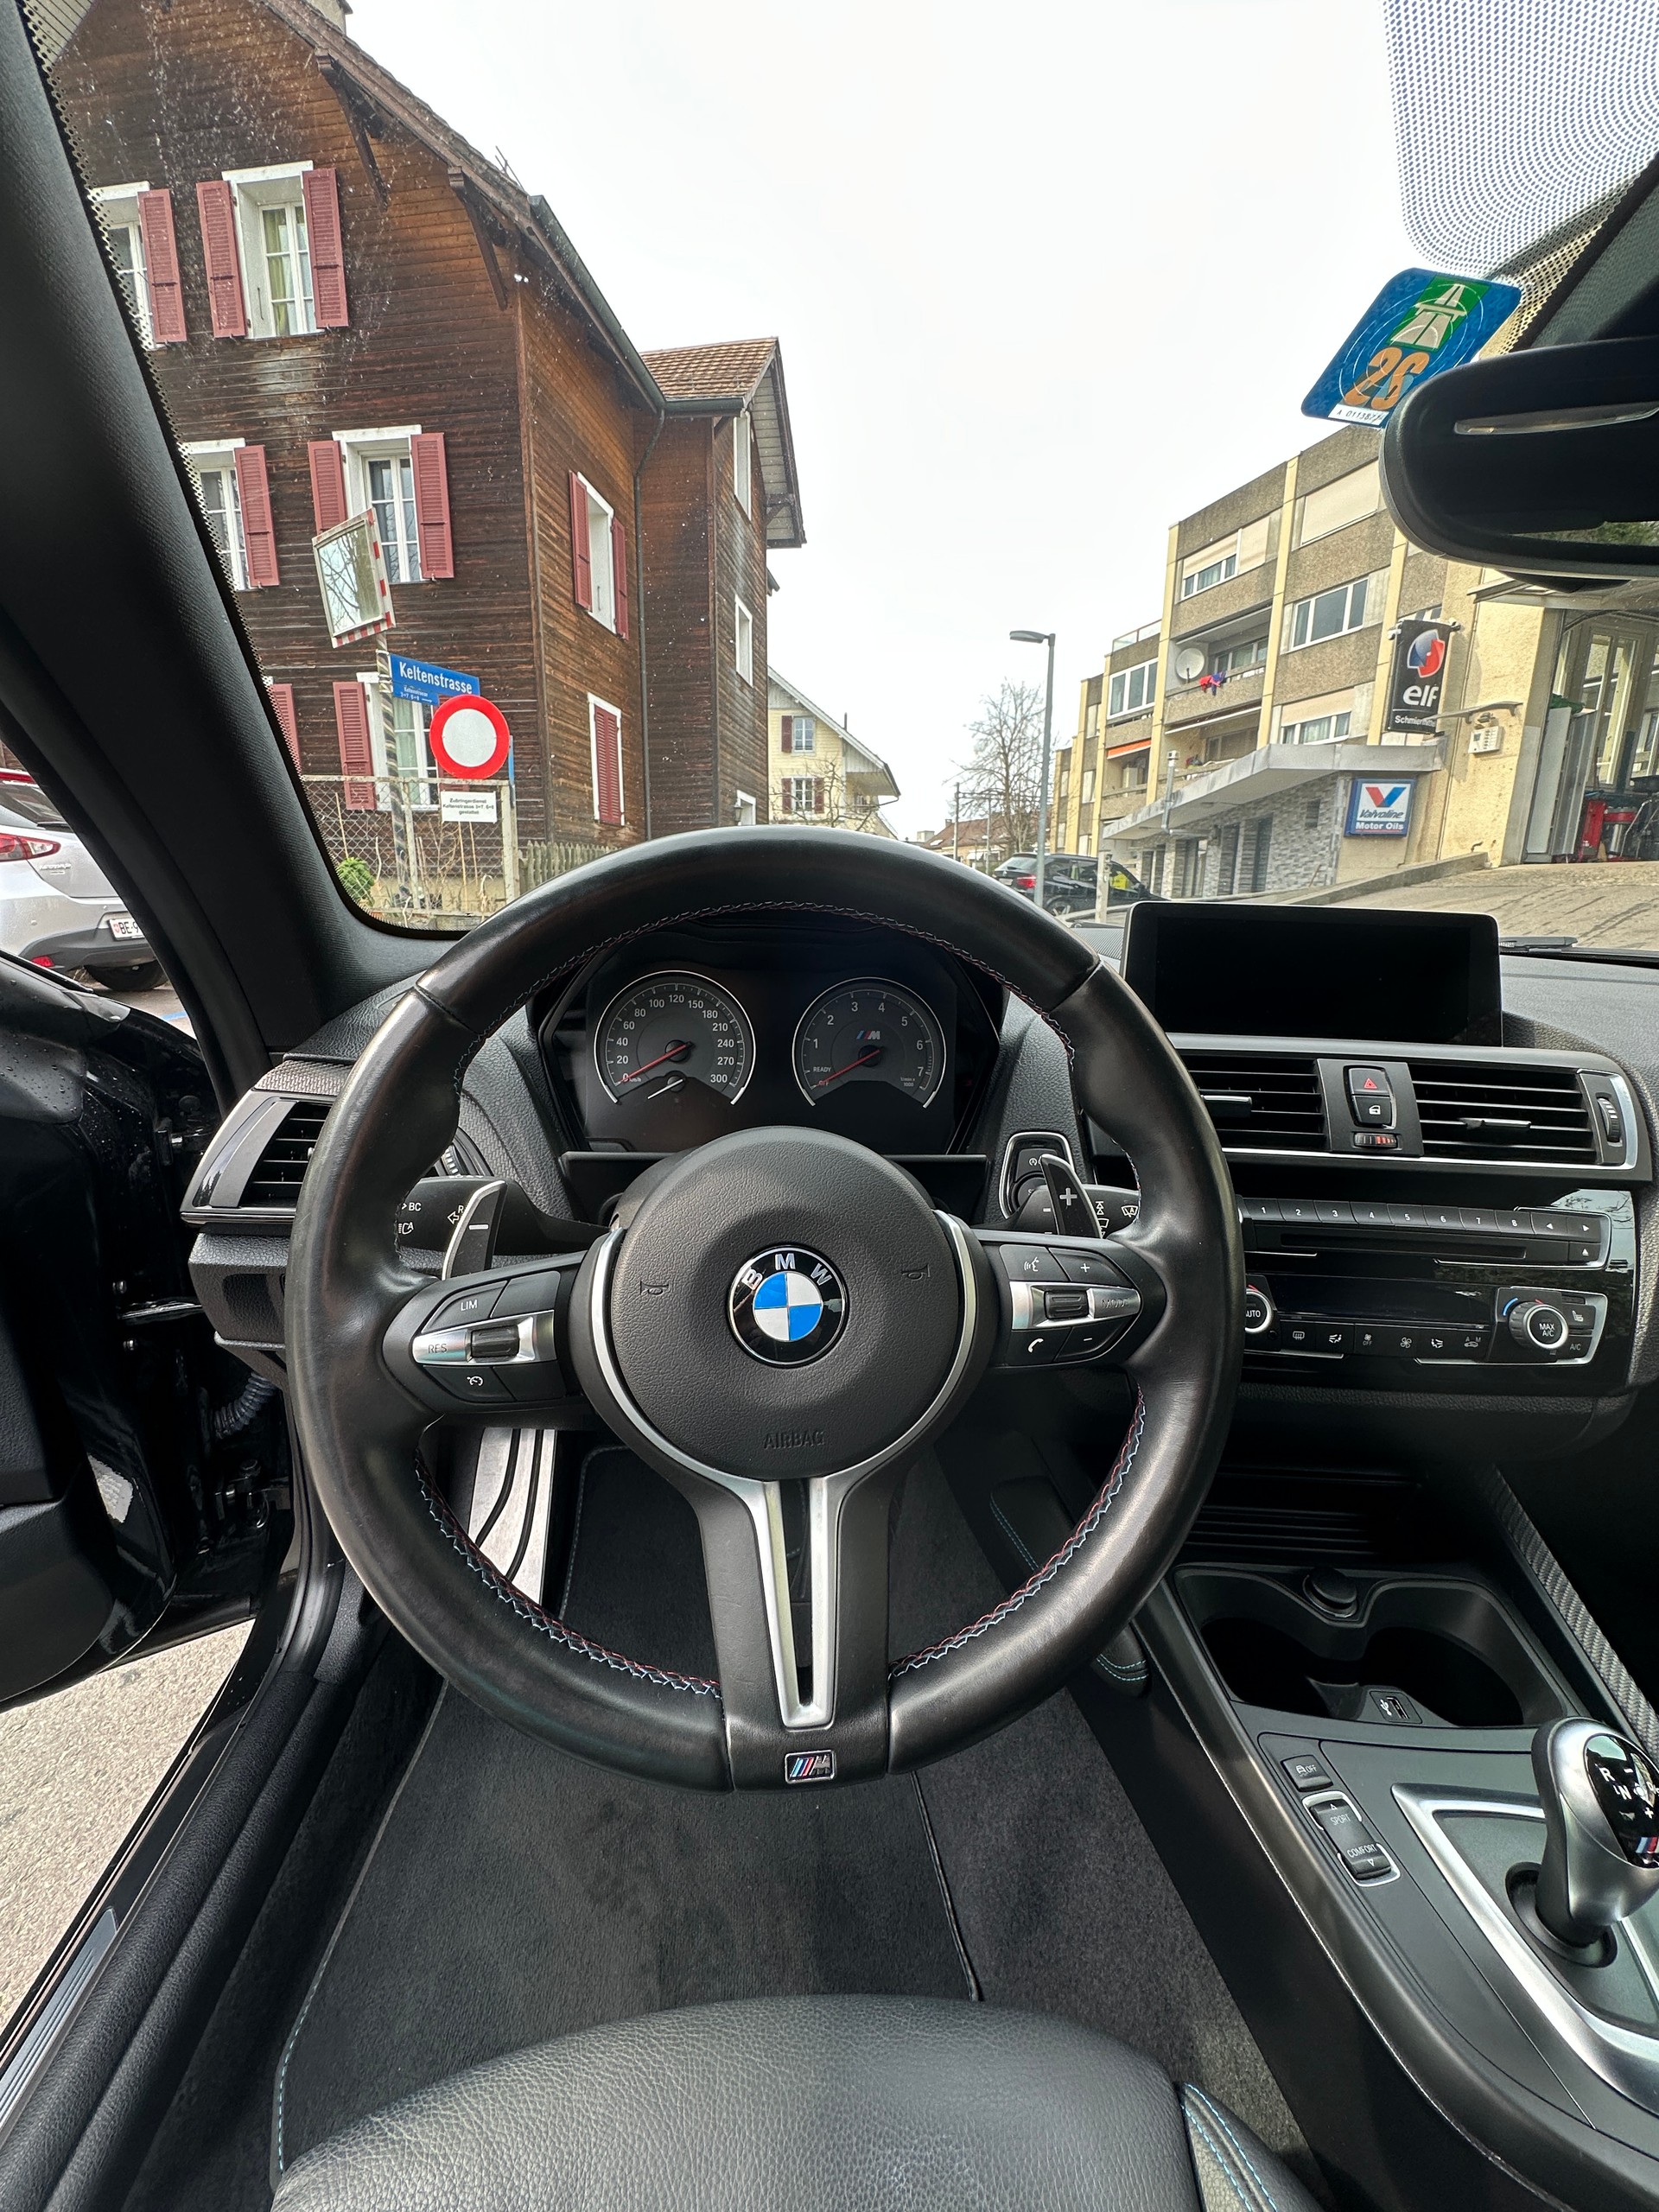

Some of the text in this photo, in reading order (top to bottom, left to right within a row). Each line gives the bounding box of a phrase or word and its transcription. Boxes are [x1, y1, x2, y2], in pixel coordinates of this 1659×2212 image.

[399, 661, 473, 694] Keltenstrasse
[1402, 684, 1440, 708] elf
[1359, 809, 1404, 819] Valvoline
[1385, 822, 1404, 830] Oils
[649, 999, 664, 1007] 100
[669, 995, 684, 1003] 120
[688, 1000, 704, 1009] 150
[851, 1002, 859, 1012] 3
[878, 1002, 886, 1013] 4
[634, 1008, 646, 1017] 80
[702, 1009, 718, 1019] 180
[827, 1014, 835, 1026] 2
[901, 1016, 908, 1027] 5
[623, 1021, 635, 1030] 60
[712, 1022, 728, 1032] 210
[616, 1038, 628, 1046] 40
[717, 1039, 734, 1048] 240
[813, 1039, 818, 1048] 1
[917, 1040, 924, 1050] 6
[616, 1055, 629, 1065] 20
[717, 1056, 734, 1065] 270
[918, 1066, 924, 1077] 7
[622, 1072, 629, 1082] 0
[710, 1074, 728, 1084] 300
[408, 1202, 422, 1211] BC
[741, 1252, 832, 1291] BMW
[461, 1300, 478, 1311] LIM
[427, 1344, 448, 1354] RES
[763, 1431, 826, 1449] AIRBAG
[1305, 1764, 1317, 1773] OFF
[1599, 1767, 1616, 1782] R
[1618, 1784, 1632, 1800] N
[1330, 1814, 1351, 1826] SPORT
[1346, 1843, 1377, 1859] COMFORT
